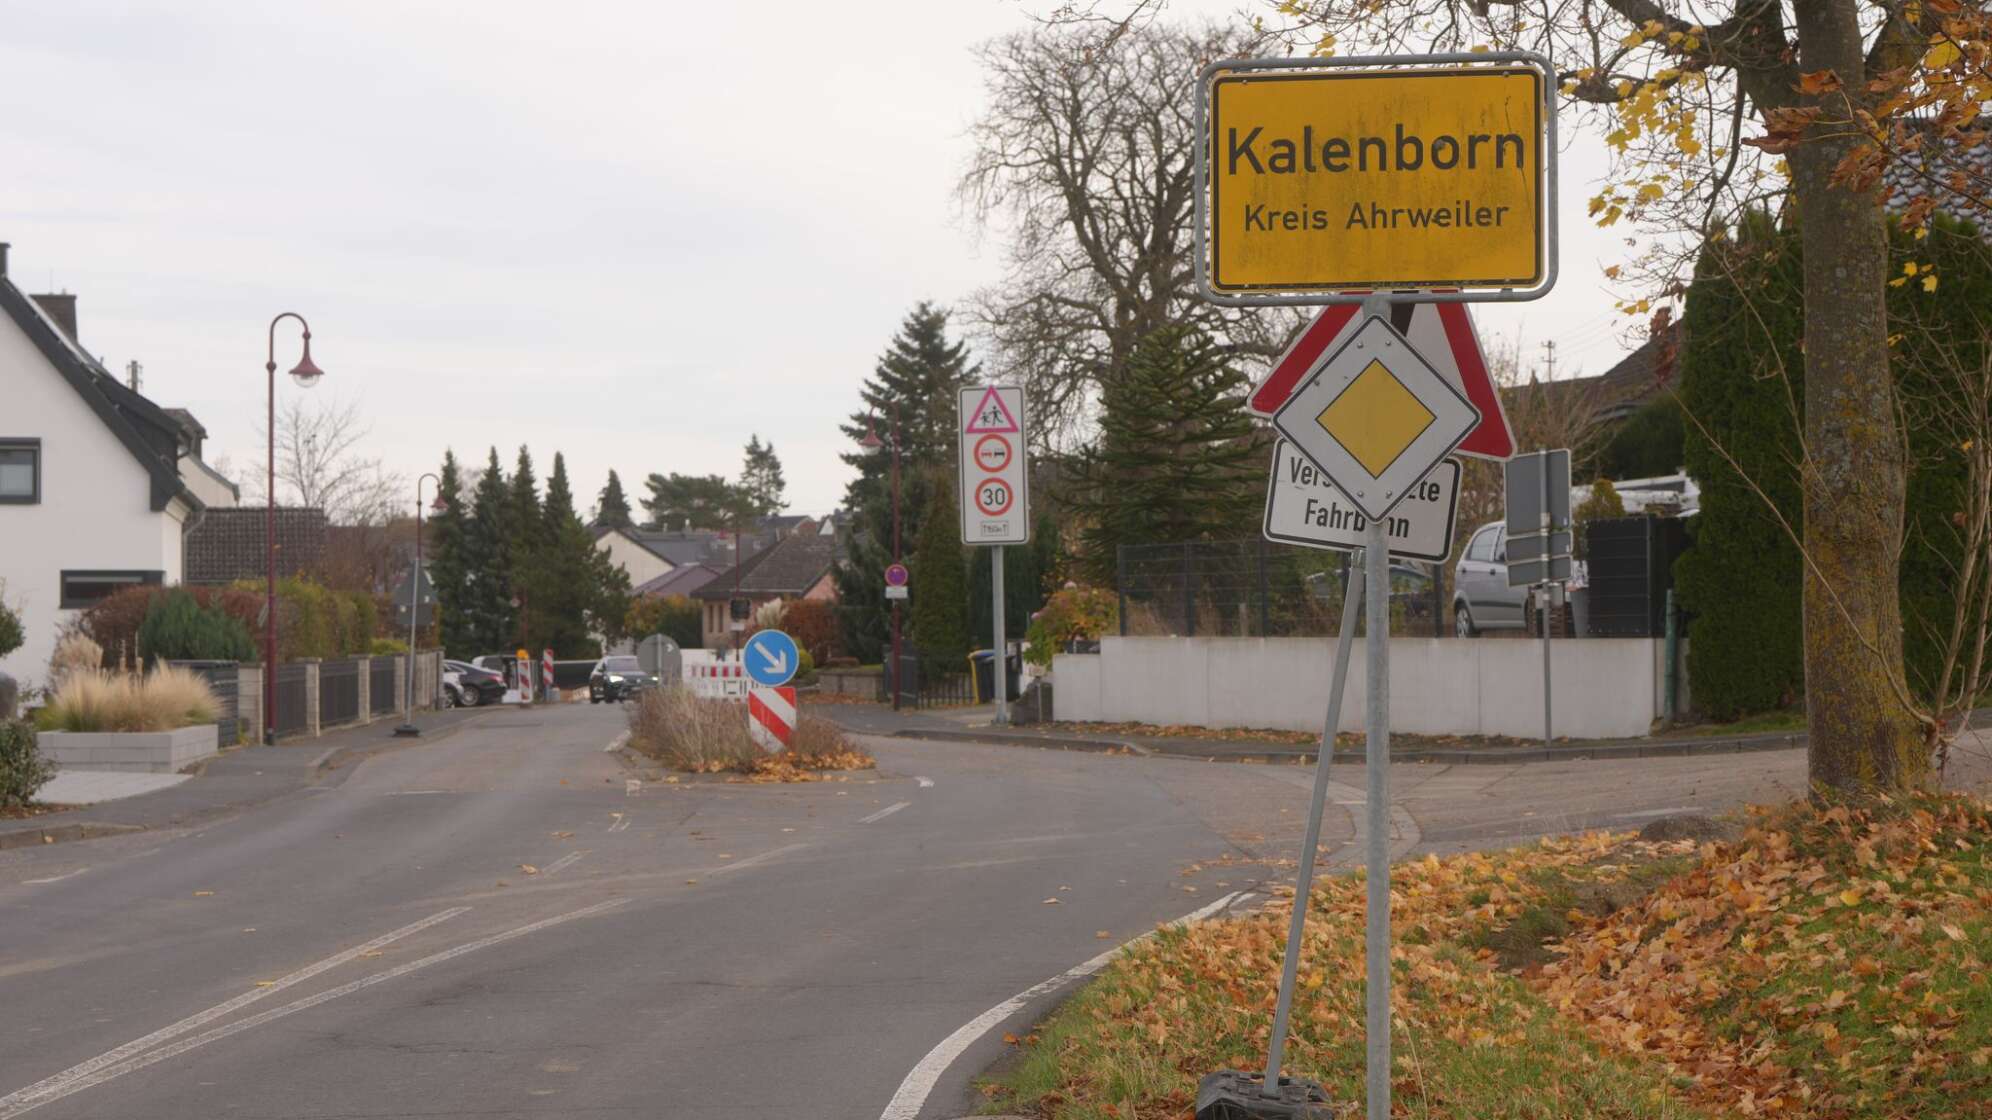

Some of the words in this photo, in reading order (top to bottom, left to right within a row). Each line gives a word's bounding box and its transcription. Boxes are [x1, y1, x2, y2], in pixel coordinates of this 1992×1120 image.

[1228, 123, 1524, 175] Kalenborn
[1245, 203, 1329, 232] Kreis
[1345, 200, 1510, 230] Ahrweiler
[983, 488, 1005, 506] 30
